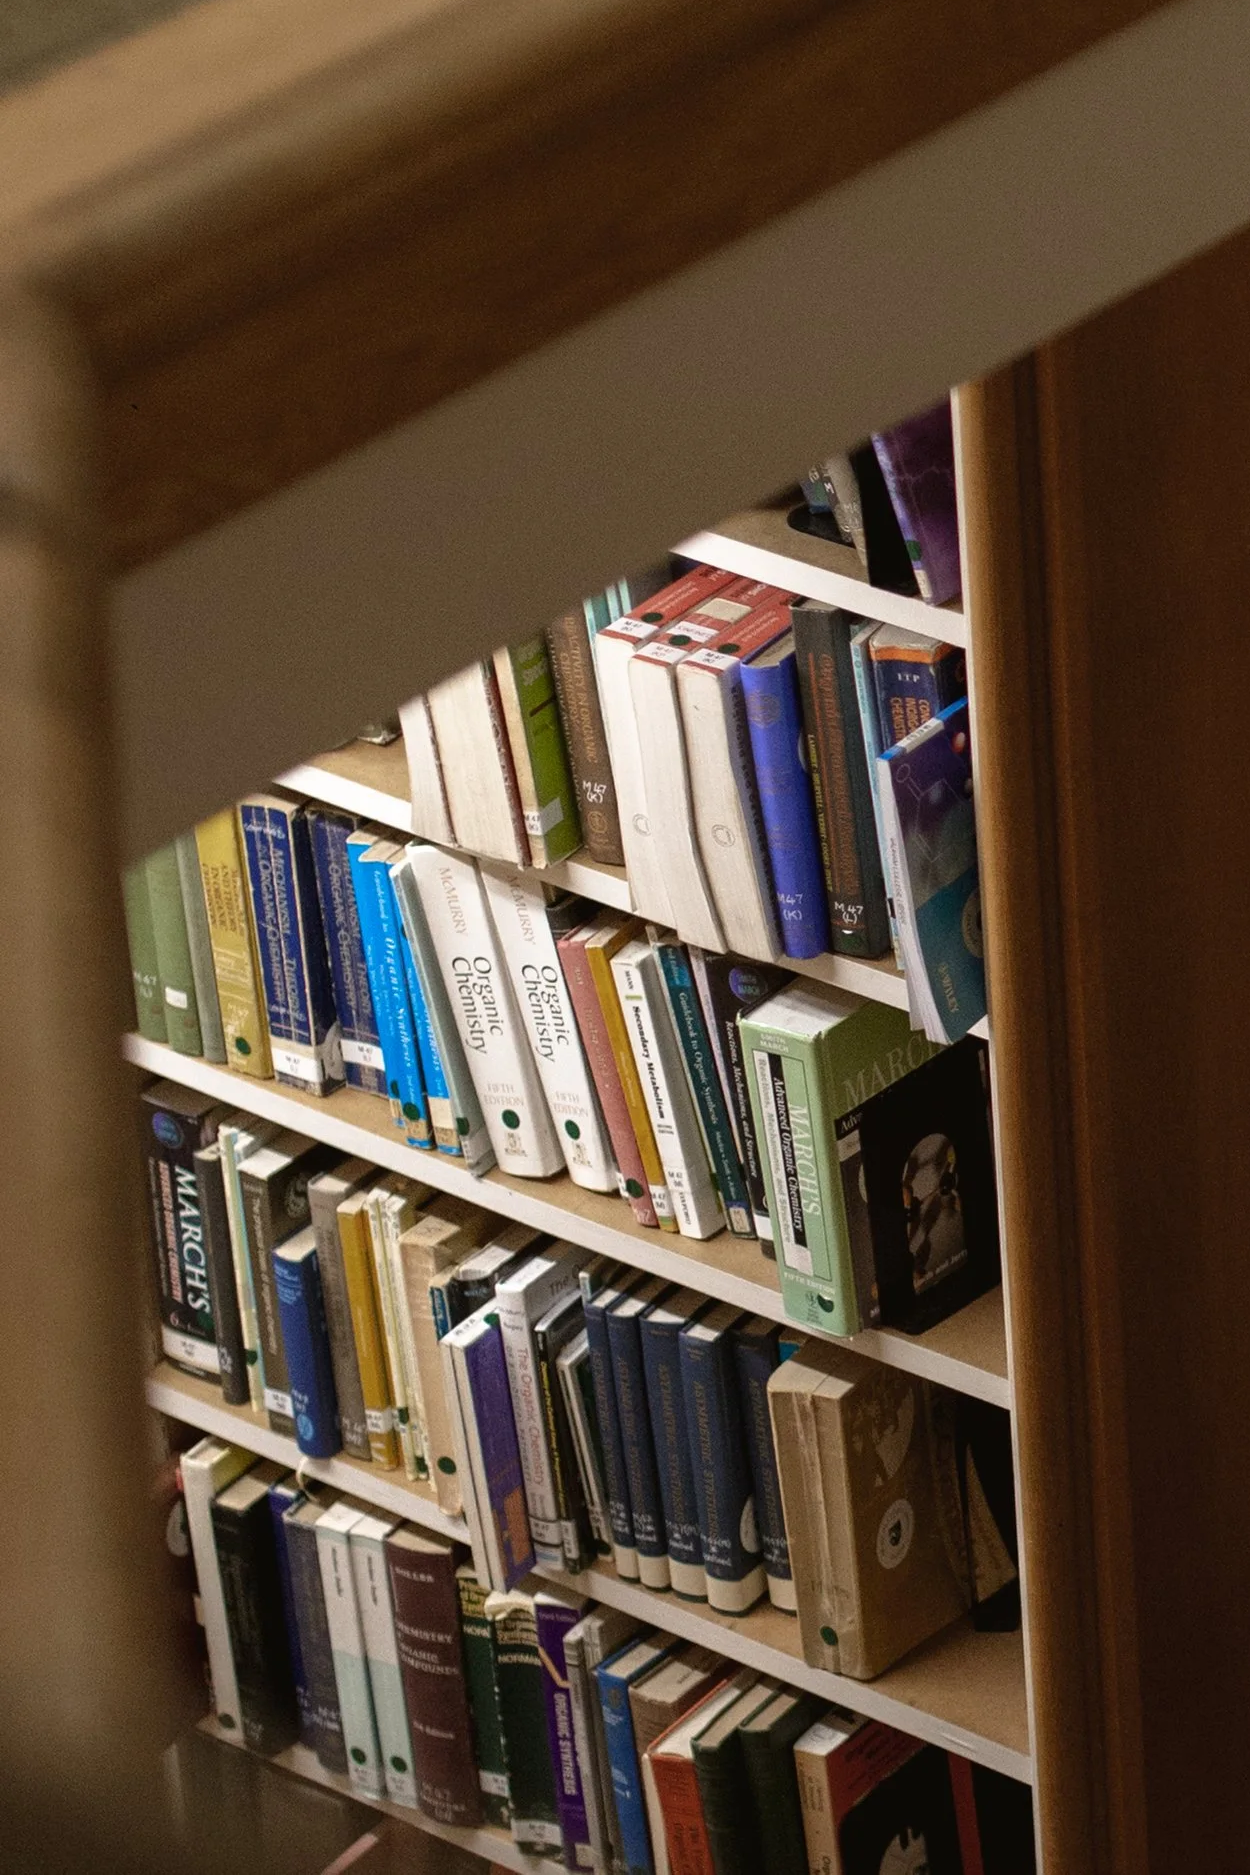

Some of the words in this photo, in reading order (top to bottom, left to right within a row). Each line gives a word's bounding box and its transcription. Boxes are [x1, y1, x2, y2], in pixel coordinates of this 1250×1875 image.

[258, 859, 277, 924] ORGANIC
[272, 847, 291, 934] MECHANISM
[438, 867, 468, 937] McMURRY
[266, 923, 288, 1006] CHEMISTRY
[384, 937, 401, 998] Organic
[472, 955, 505, 1037] Organic
[452, 955, 489, 1055] Chemistry
[521, 963, 556, 1063] Chemistry
[540, 965, 570, 1047] Organic
[632, 1005, 650, 1059] Secondary
[646, 1061, 666, 1120] Metabolism
[678, 992, 696, 1038] Guidebook
[693, 1051, 708, 1088] Organic
[701, 1087, 718, 1125] Synthesis
[725, 1021, 737, 1065] Reactions,
[732, 1066, 747, 1119] Mechanisms,
[744, 1138, 758, 1178] Structure
[773, 1076, 789, 1131] Advanced
[780, 1133, 797, 1171] Organic
[788, 1103, 822, 1217] MARCH'S
[786, 1171, 803, 1232] Chemistry
[174, 1164, 212, 1314] MARCH'S
[516, 1346, 529, 1370] The
[519, 1371, 537, 1421] Organic
[528, 1424, 546, 1486] Chemistry
[496, 1652, 543, 1667] NORMAN
